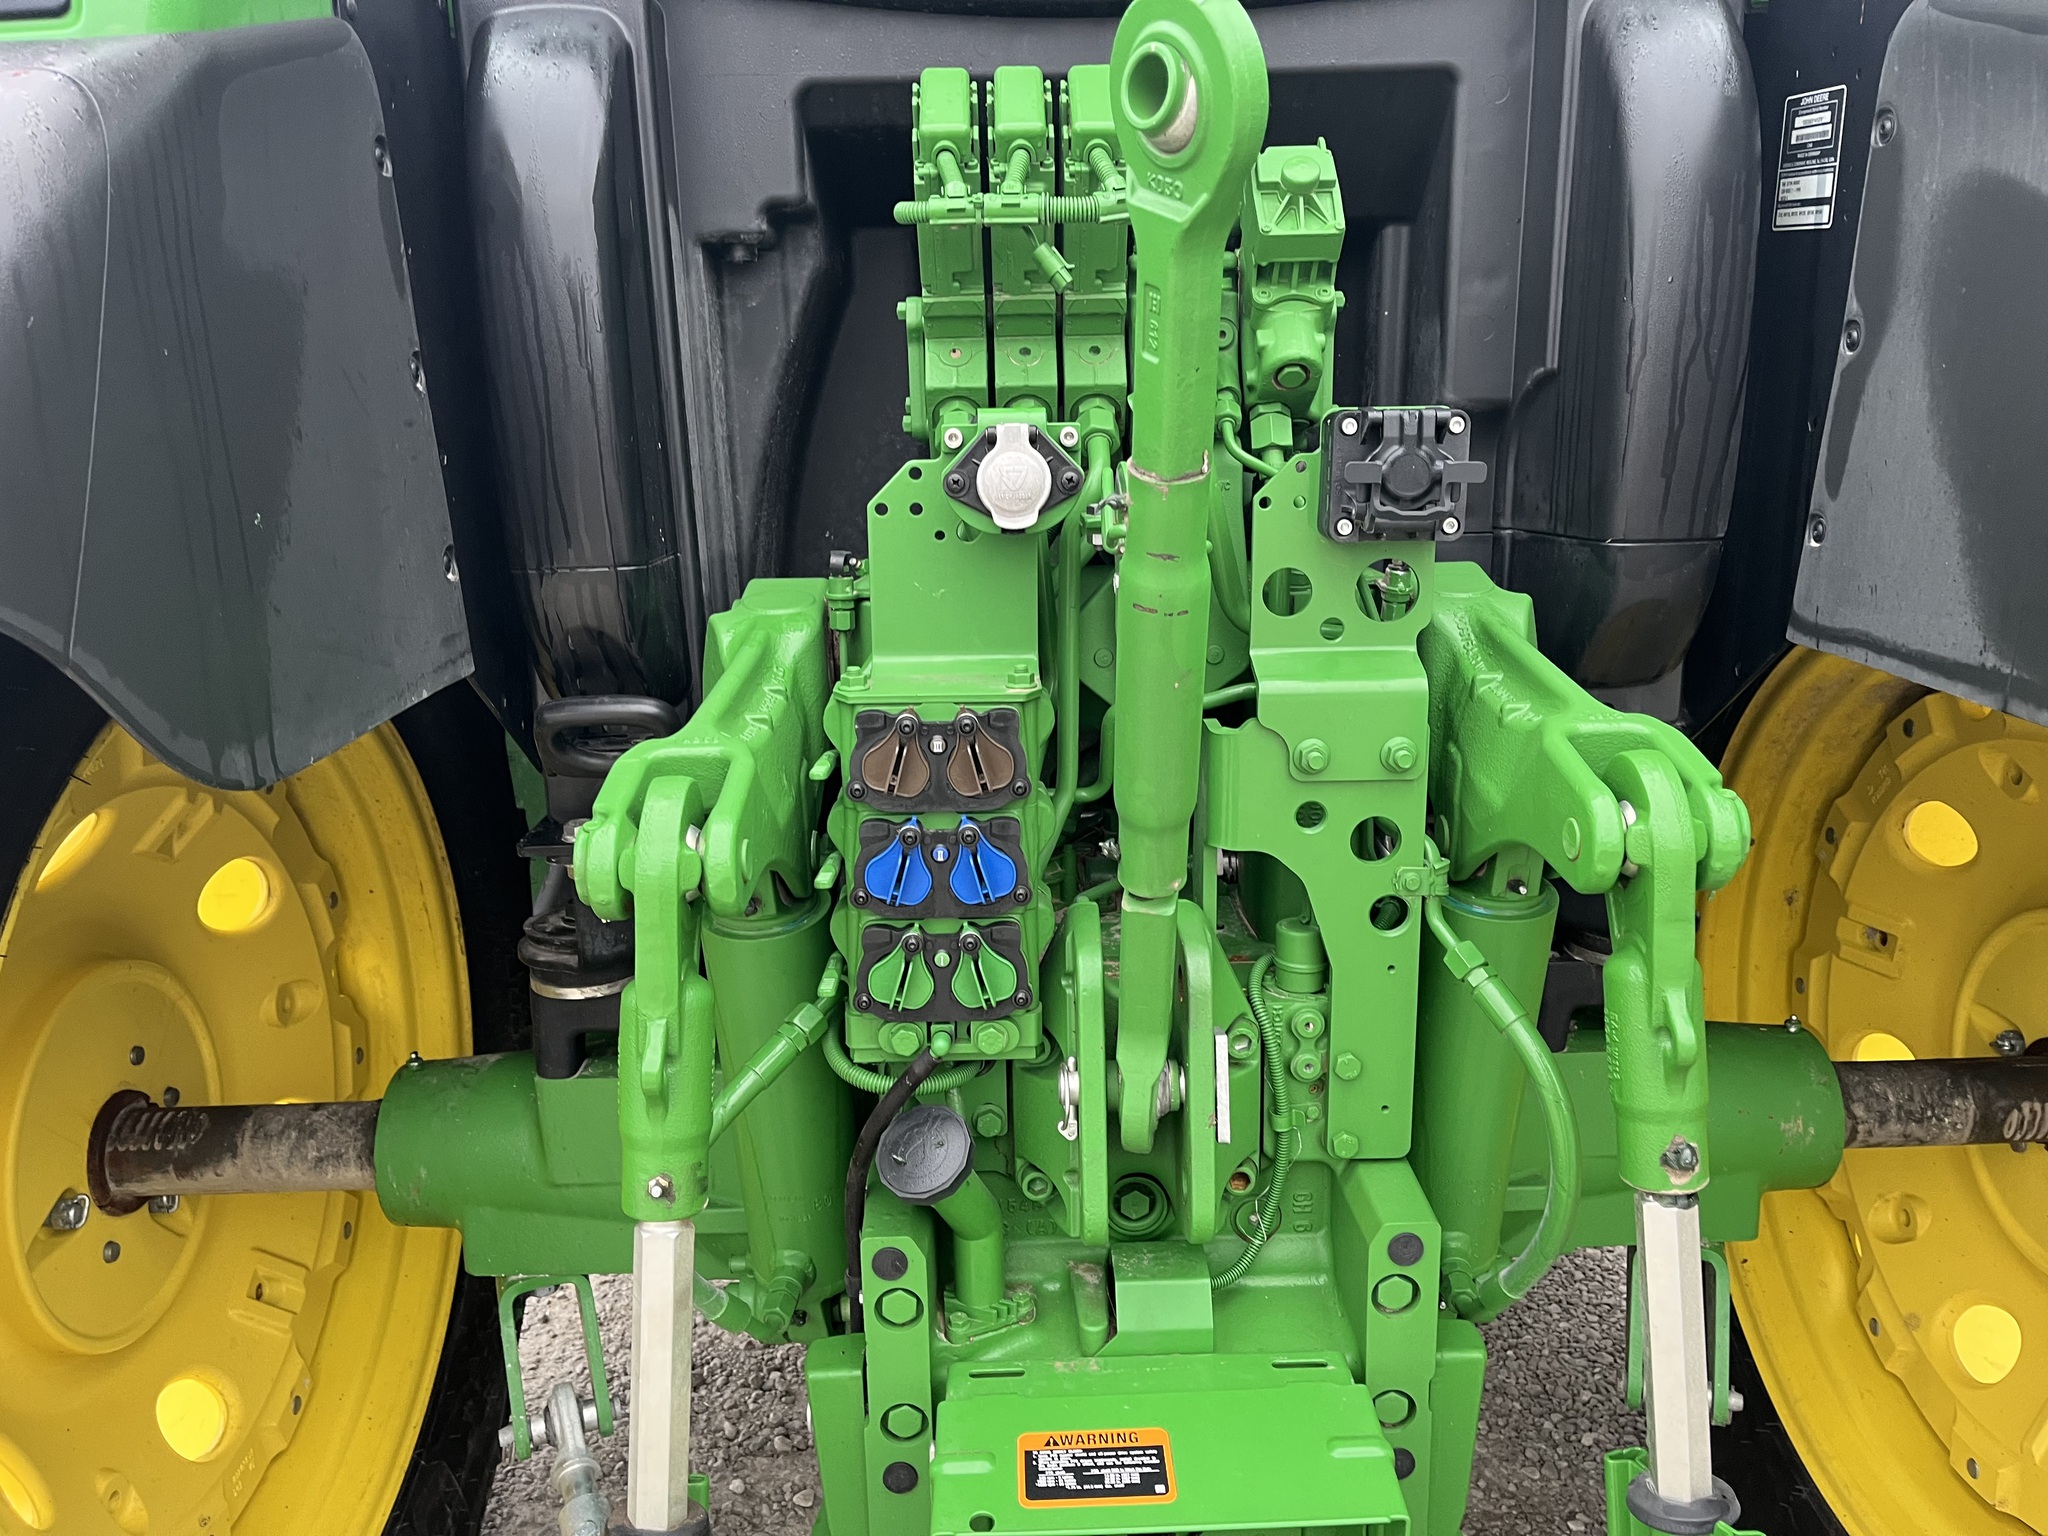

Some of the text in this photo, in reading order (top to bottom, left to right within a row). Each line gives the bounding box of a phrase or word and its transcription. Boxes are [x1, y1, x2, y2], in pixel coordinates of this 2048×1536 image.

[1800, 92, 1830, 106] JOHN DEERE
[1059, 1432, 1139, 1446] WARNING
